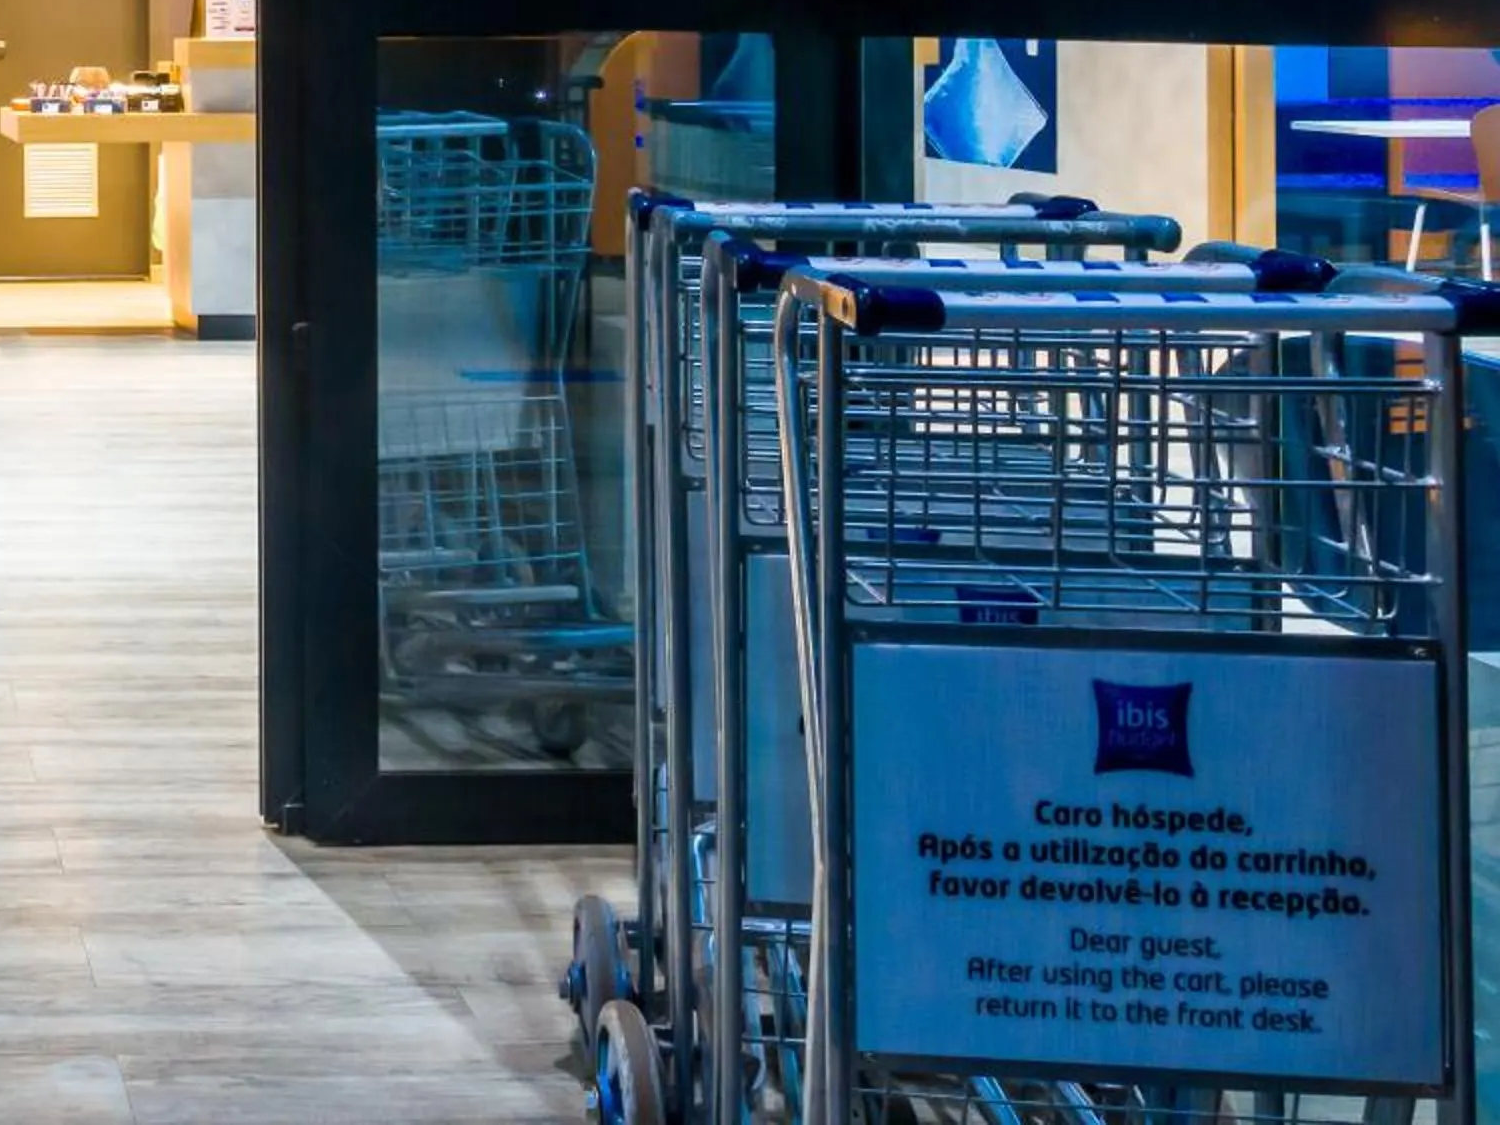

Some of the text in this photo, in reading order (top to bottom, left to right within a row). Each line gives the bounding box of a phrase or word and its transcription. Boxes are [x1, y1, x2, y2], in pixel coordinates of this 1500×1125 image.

[1116, 699, 1170, 730] ibis
[1033, 799, 1253, 837] Caro hóspede,
[917, 832, 993, 865] Após
[1002, 840, 1021, 862] a
[1030, 836, 1181, 873] utilização
[1236, 848, 1377, 881] carrinho,
[929, 869, 1371, 921] favor devolvê-lo à recepção.
[1070, 926, 1222, 961] Dear guest,
[967, 955, 1034, 983] After
[1042, 962, 1113, 993] using
[1120, 963, 1166, 992] the
[1239, 970, 1330, 1001] please
[975, 994, 1323, 1035] return it to the front desk.
